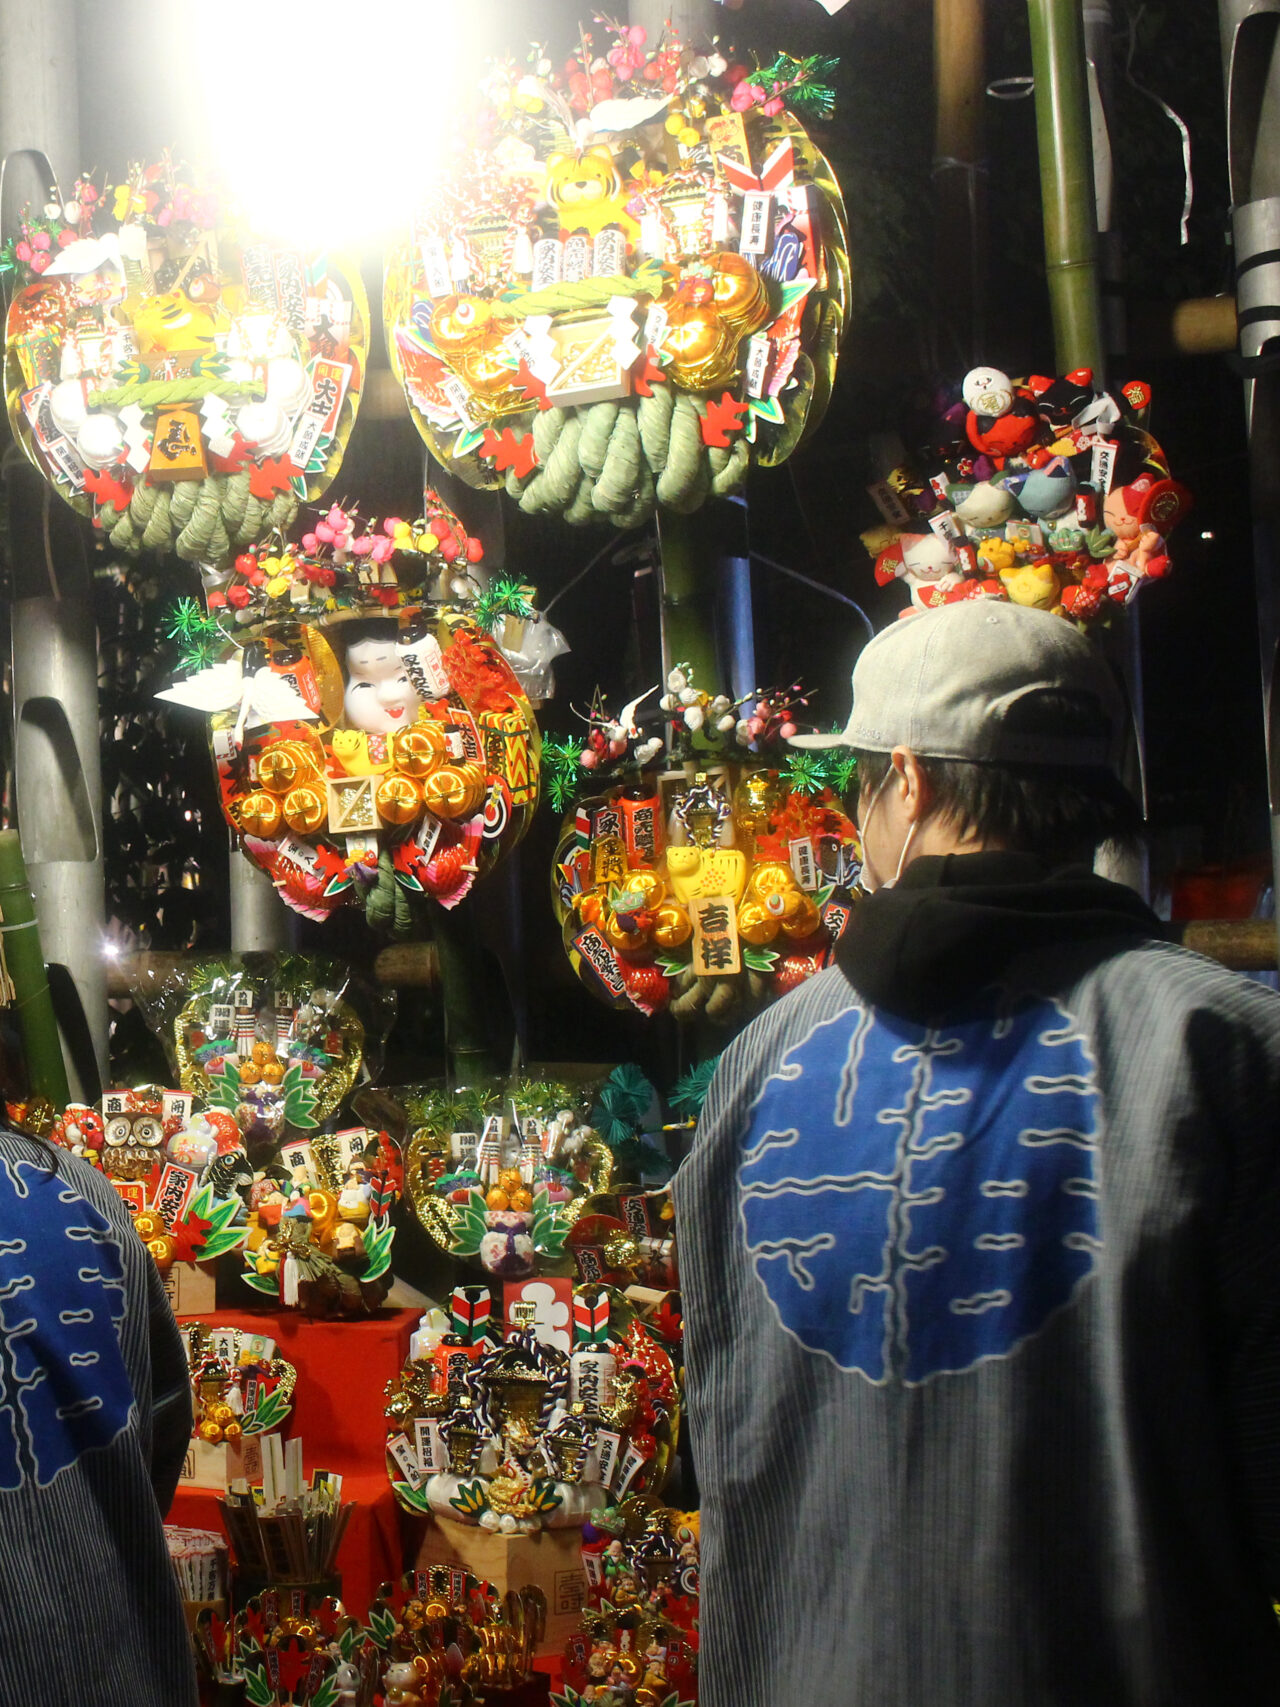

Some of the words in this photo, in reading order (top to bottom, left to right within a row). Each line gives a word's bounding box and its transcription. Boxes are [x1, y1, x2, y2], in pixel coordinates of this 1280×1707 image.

[598, 812, 620, 838] 家
[698, 902, 734, 969] 吉祥
[107, 1099, 122, 1113] 商
[289, 1151, 306, 1168] 商
[159, 1170, 189, 1231] 家内安全
[219, 1337, 230, 1357] 大願
[420, 1426, 434, 1468] 開運招福
